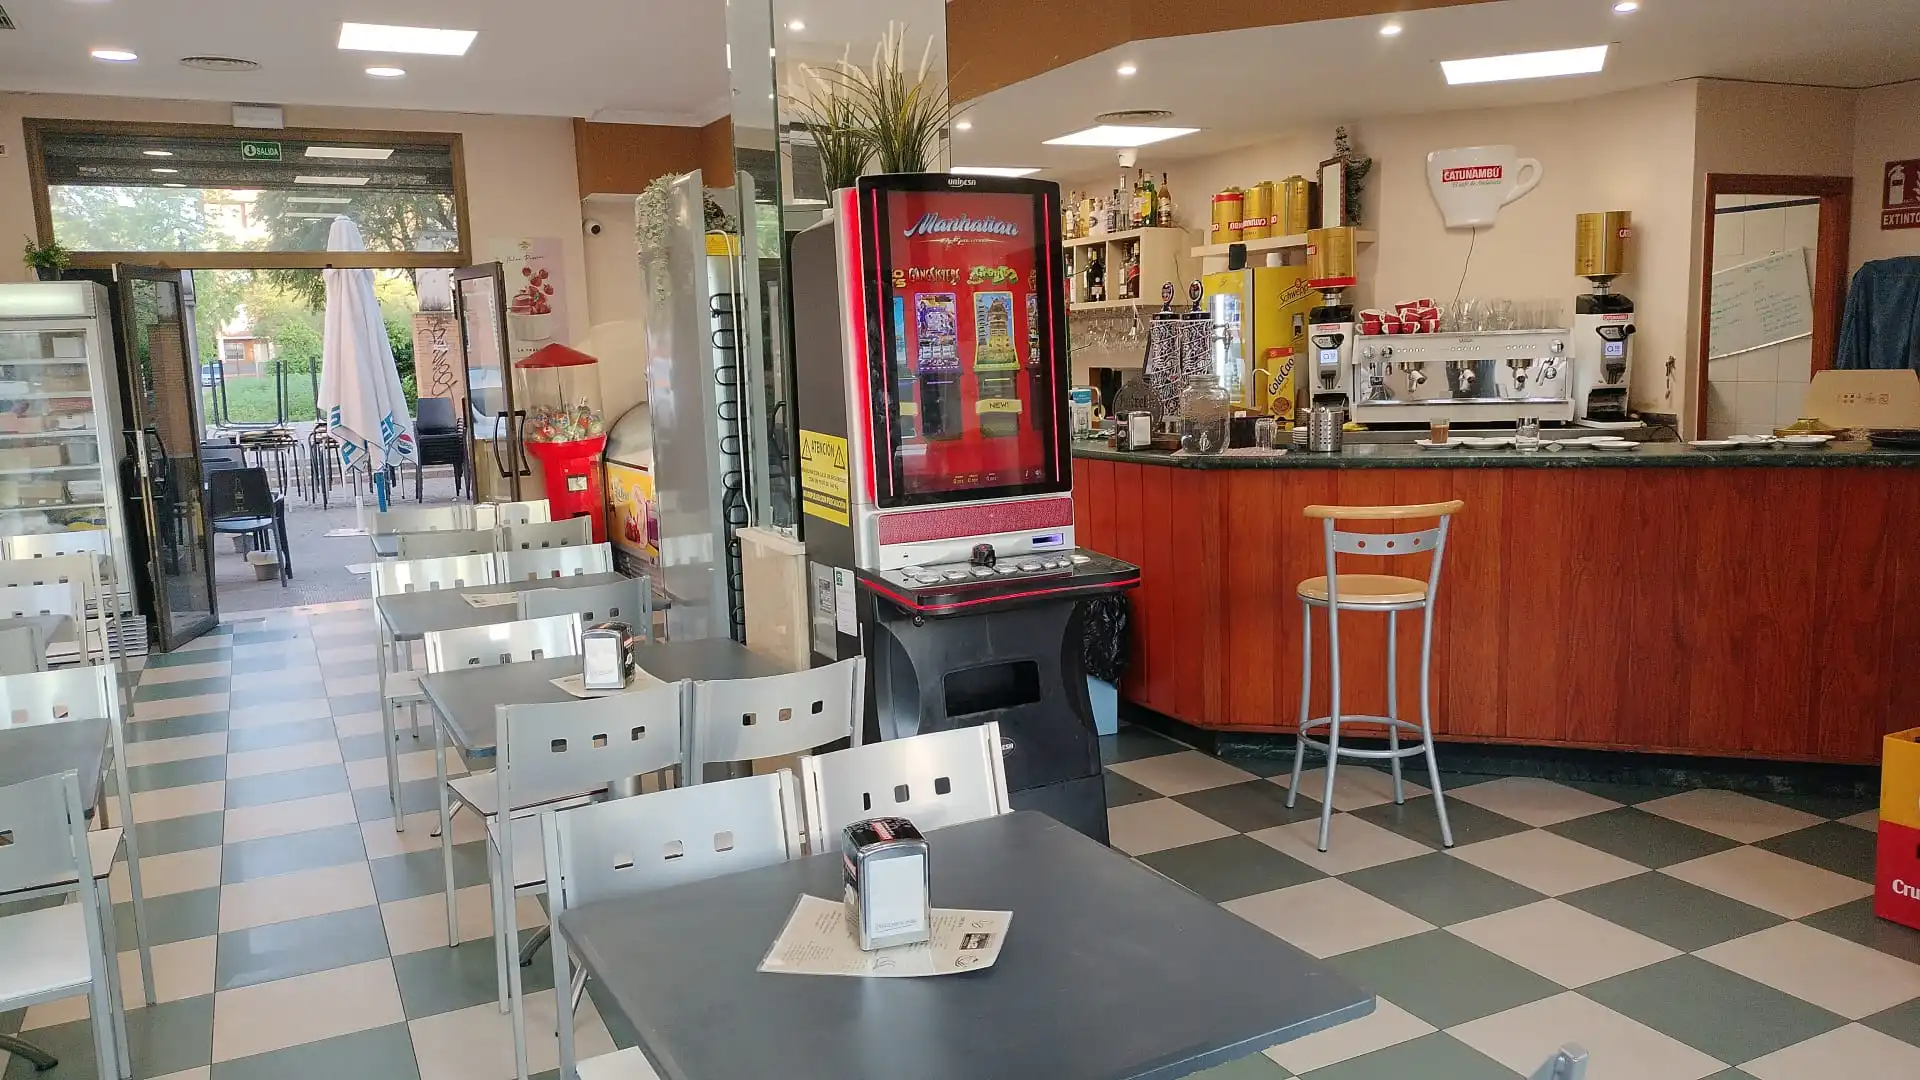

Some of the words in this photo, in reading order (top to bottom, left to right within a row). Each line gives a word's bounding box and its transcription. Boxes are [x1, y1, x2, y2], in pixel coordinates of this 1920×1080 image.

[256, 147, 279, 156] SALIDA
[1444, 167, 1501, 181] CATUNAMBÚ
[903, 211, 1020, 238] Manhattan
[1268, 358, 1294, 396] ColaCao
[989, 400, 1009, 409] NEW!
[811, 439, 835, 458] ATENCIÓN
